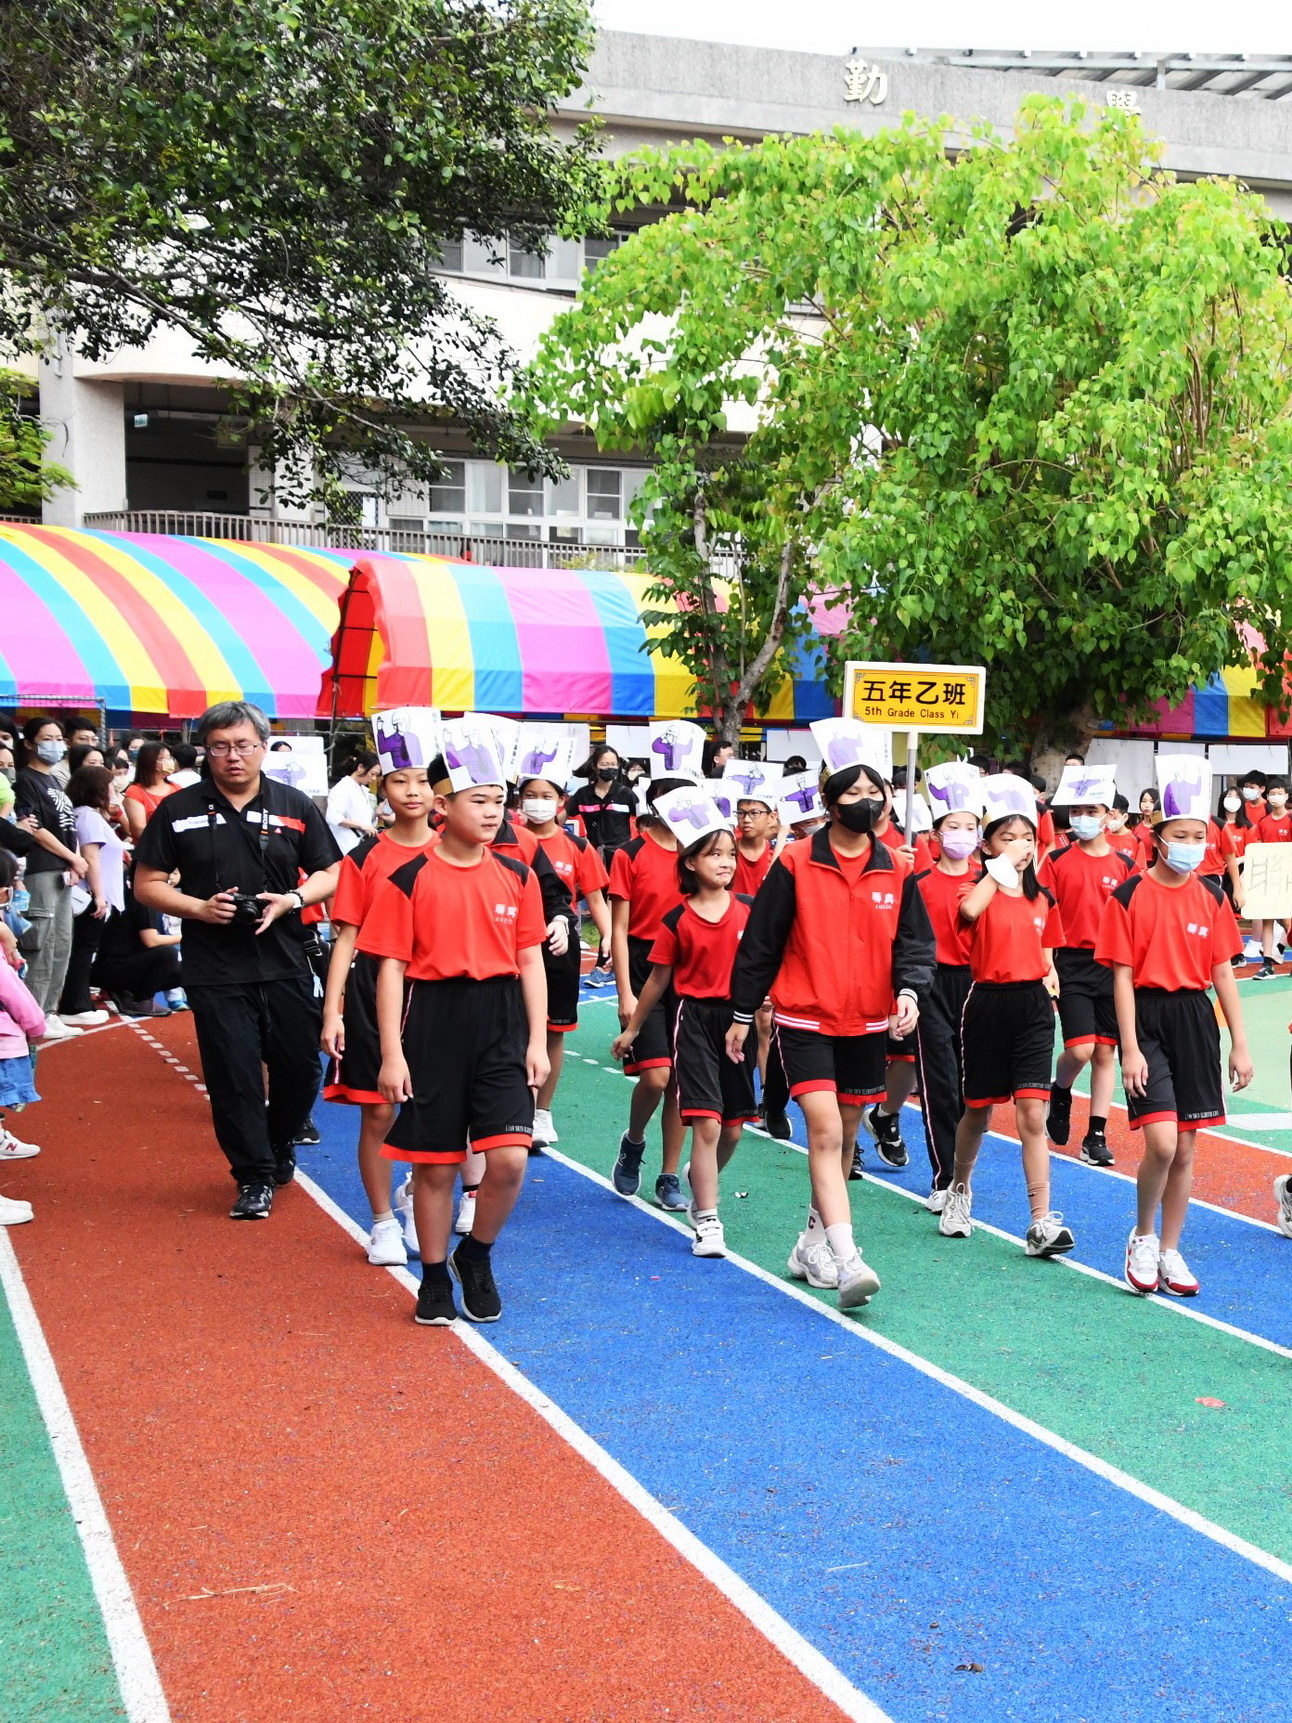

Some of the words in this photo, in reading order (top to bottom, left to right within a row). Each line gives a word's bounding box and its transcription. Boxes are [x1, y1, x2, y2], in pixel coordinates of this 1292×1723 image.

[861, 680, 967, 705] 五年乙班
[865, 706, 882, 716] 5th
[887, 708, 915, 718] Grade
[920, 709, 945, 719] Class
[950, 710, 959, 719] Yi
